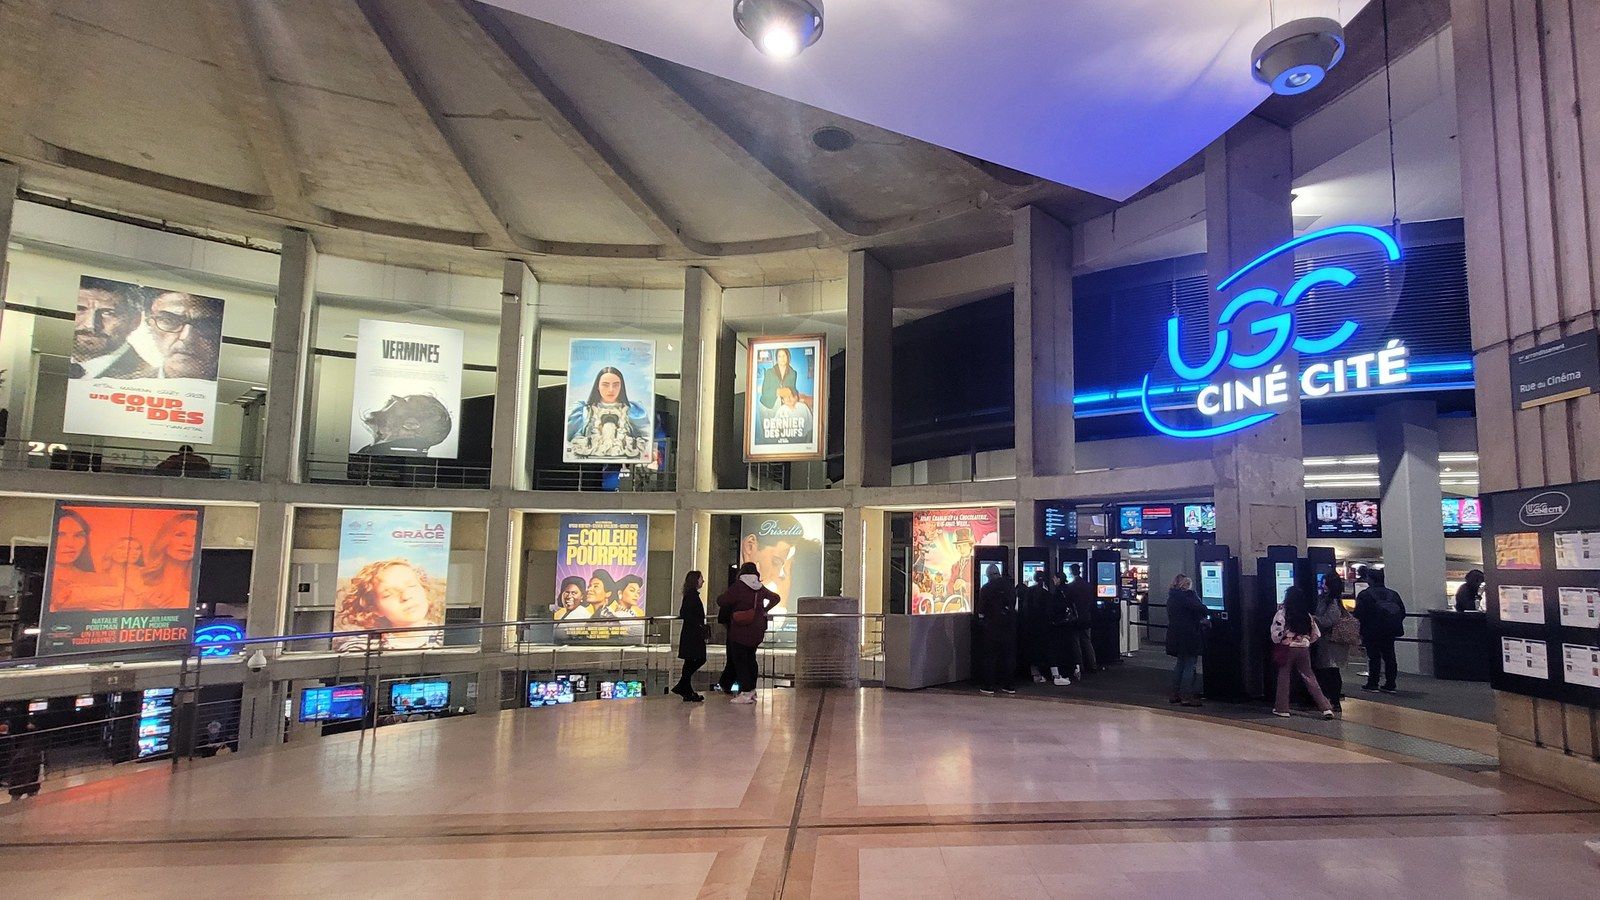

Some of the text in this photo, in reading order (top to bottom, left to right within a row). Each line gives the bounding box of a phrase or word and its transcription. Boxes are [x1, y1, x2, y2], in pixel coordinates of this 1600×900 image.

[1167, 266, 1358, 381] UGC
[382, 339, 440, 363] VERMINES
[1196, 339, 1408, 416] CINÉ CITÉ
[1520, 383, 1536, 392] Rue
[1547, 371, 1581, 386] Cinéma
[110, 393, 183, 409] COUP
[763, 416, 805, 430] DERNIER
[764, 428, 803, 439] DES JUIFS
[392, 530, 445, 539] GRÂCE
[424, 523, 445, 531] LA
[758, 519, 803, 536] Priscilla
[580, 529, 638, 546] COULEUR
[566, 545, 637, 566] POURPRE
[120, 616, 149, 629] MAY
[119, 627, 188, 643] DECEMBER
